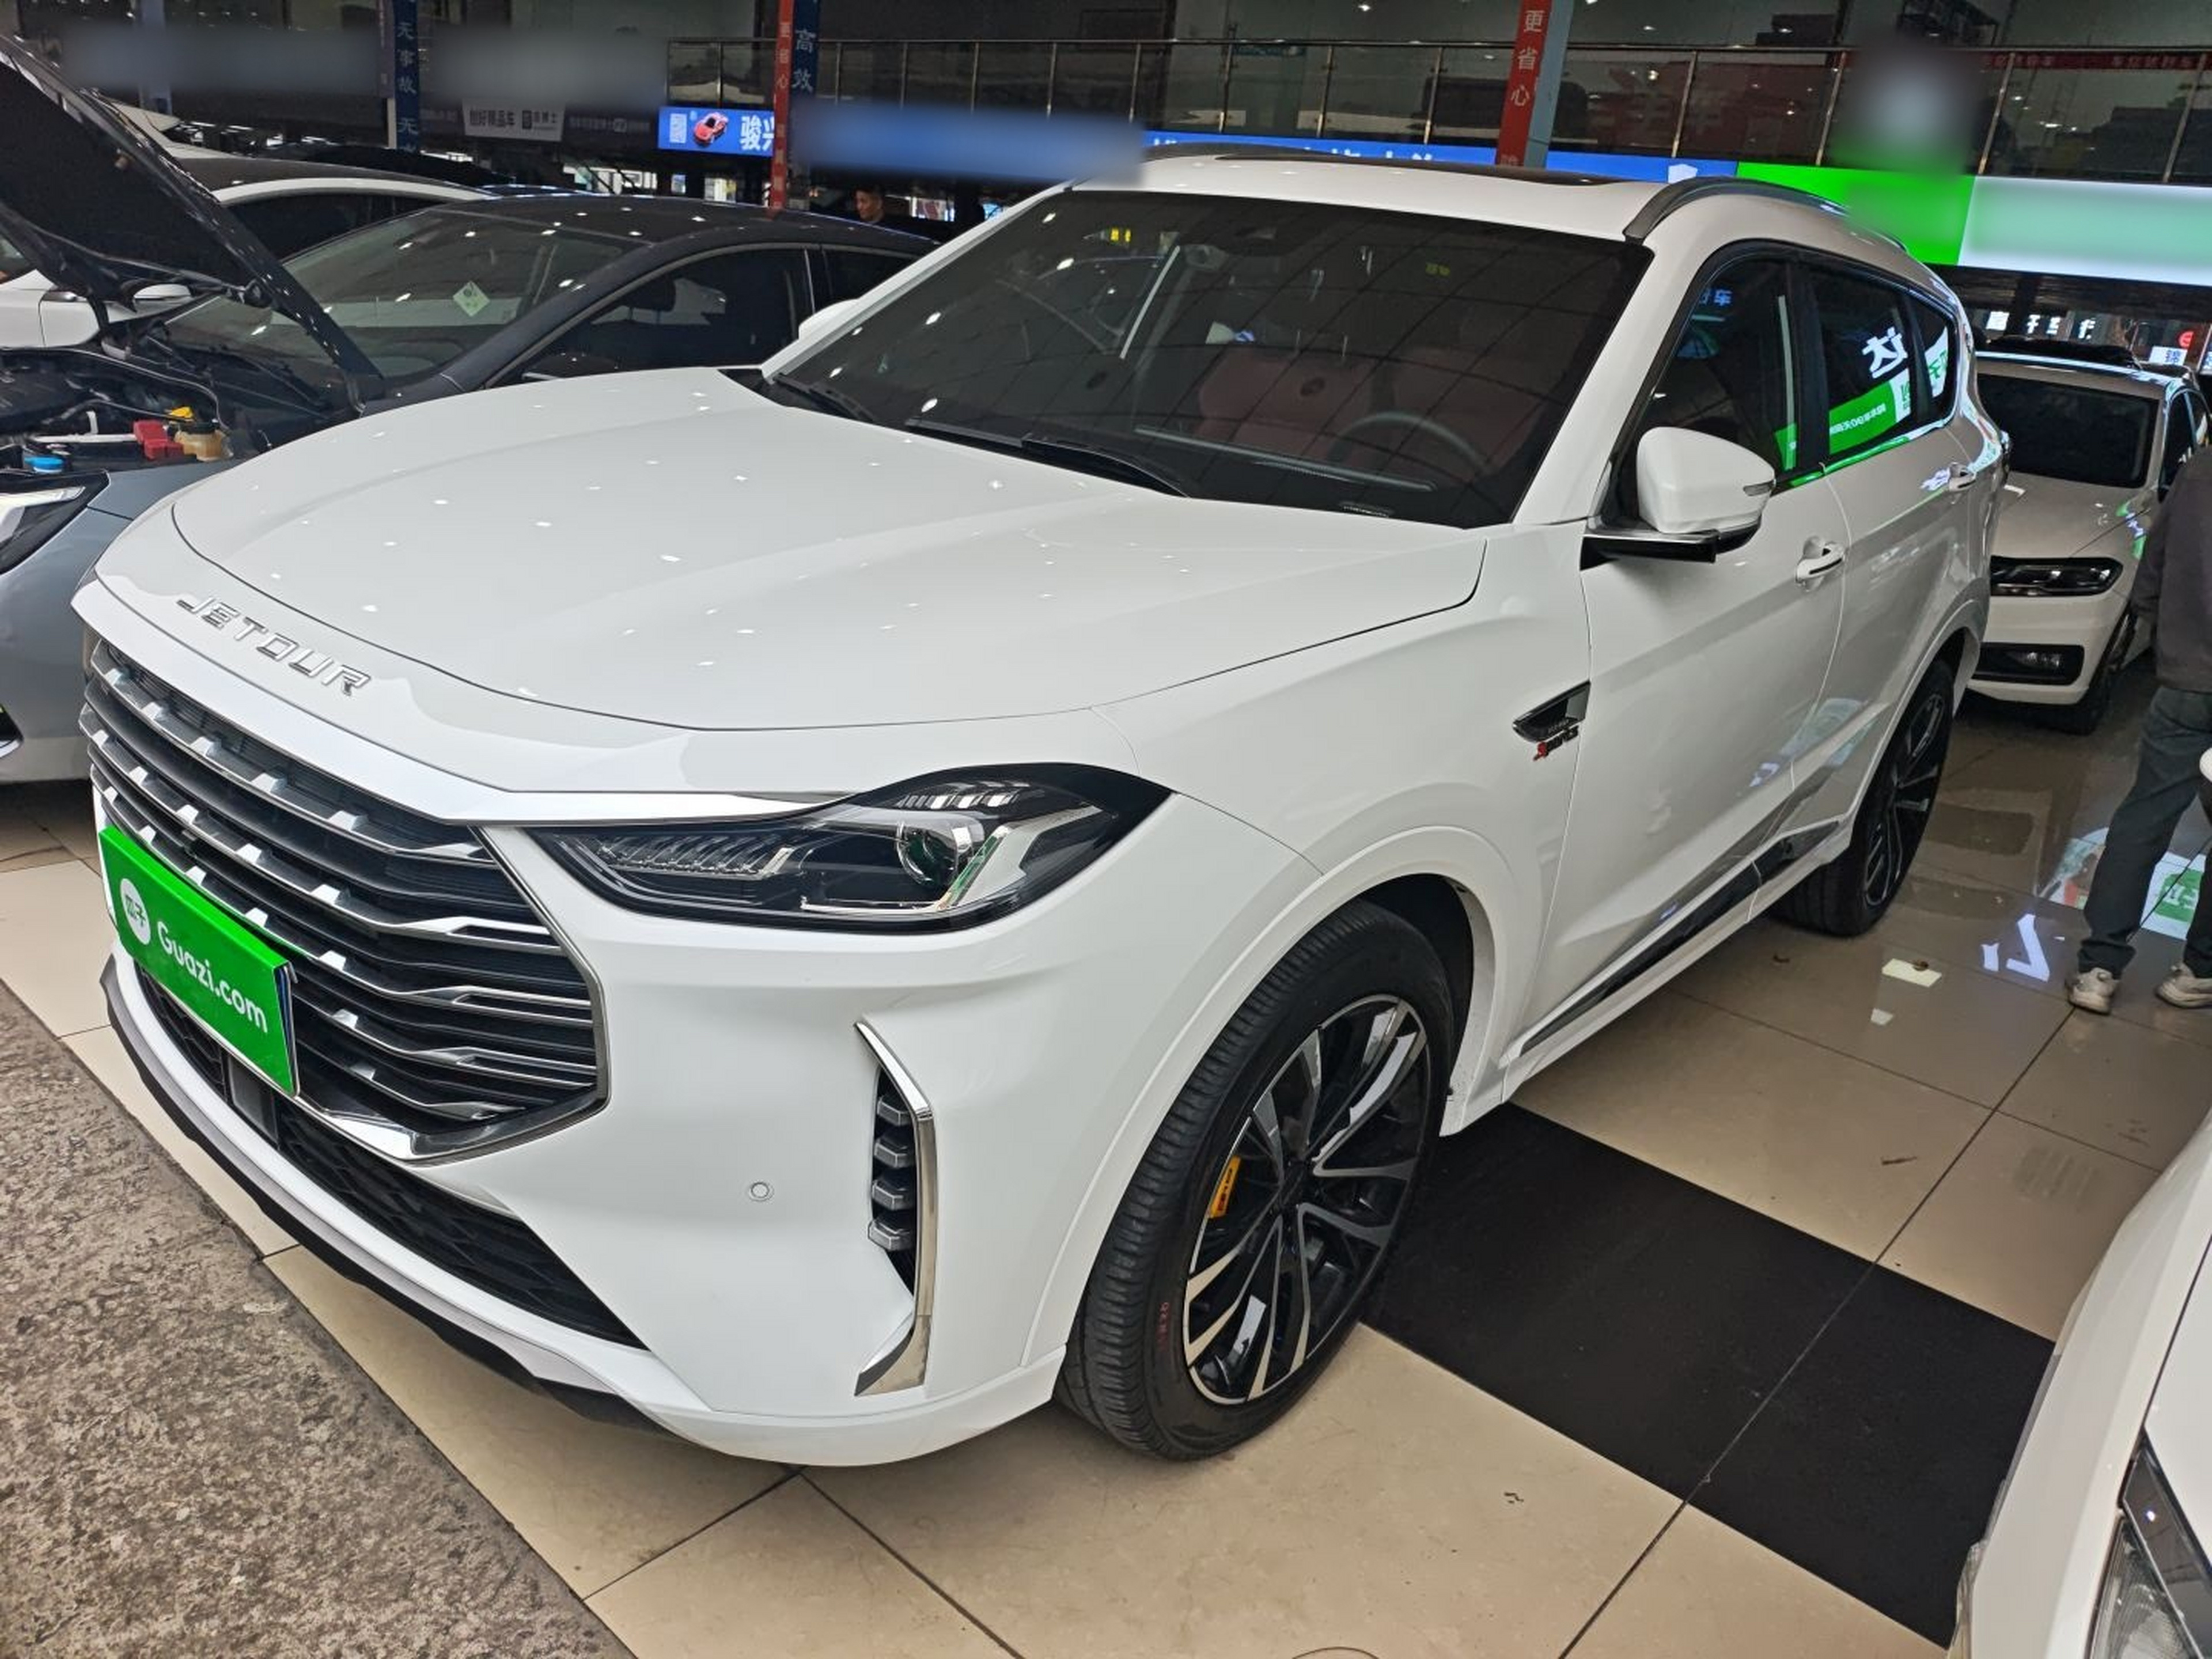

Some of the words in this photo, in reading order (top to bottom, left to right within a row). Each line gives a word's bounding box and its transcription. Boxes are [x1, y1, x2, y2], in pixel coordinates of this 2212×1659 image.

[1510, 10, 1544, 107] 更省心
[176, 597, 371, 696] JETOUR
[157, 921, 268, 1033] Guazi.com
